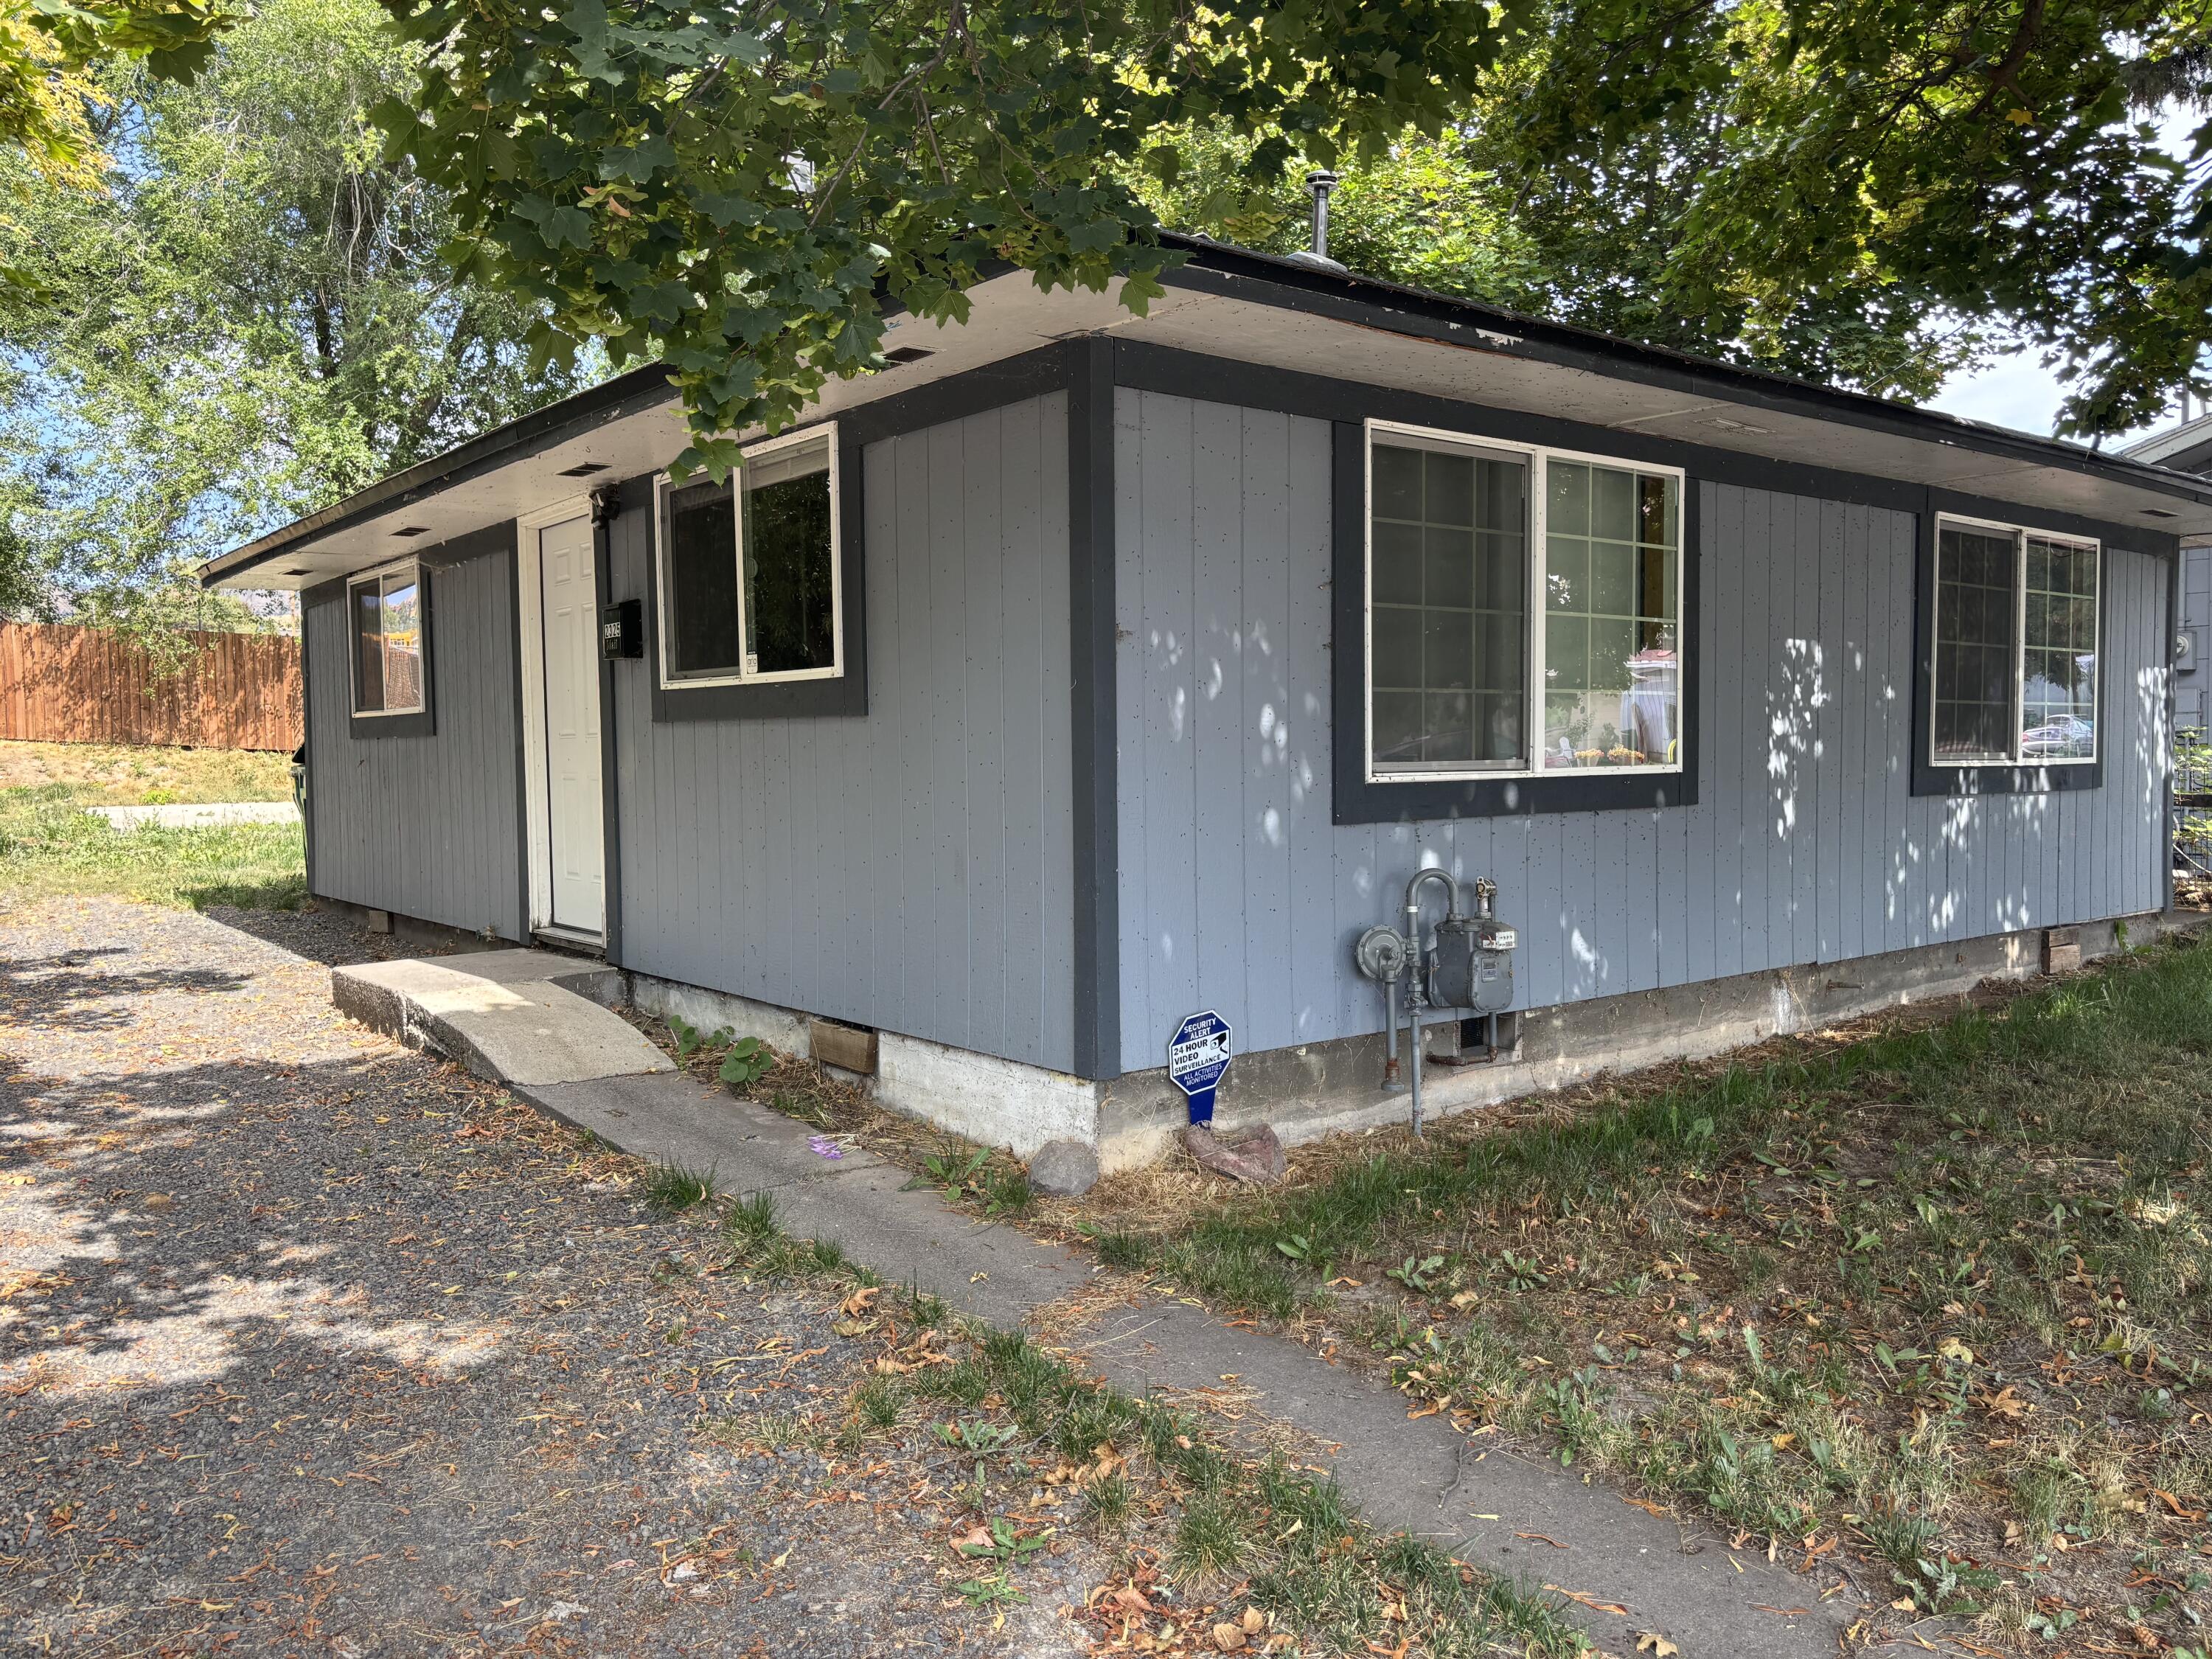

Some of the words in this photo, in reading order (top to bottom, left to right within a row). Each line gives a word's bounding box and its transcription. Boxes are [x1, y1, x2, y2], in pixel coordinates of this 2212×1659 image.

[605, 623, 620, 637] 2325
[1183, 1018, 1217, 1033] SECURITY
[1190, 1027, 1211, 1040] ALERT
[1174, 1046, 1183, 1056] 24
[1185, 1039, 1208, 1053] HOUR
[1174, 1051, 1199, 1065] VIDEO
[1175, 1054, 1221, 1074] SURVEILLANCE
[1183, 1073, 1193, 1082] ALL
[1194, 1062, 1222, 1077] ACTIVITIES
[1186, 1071, 1218, 1086] MONITORED
